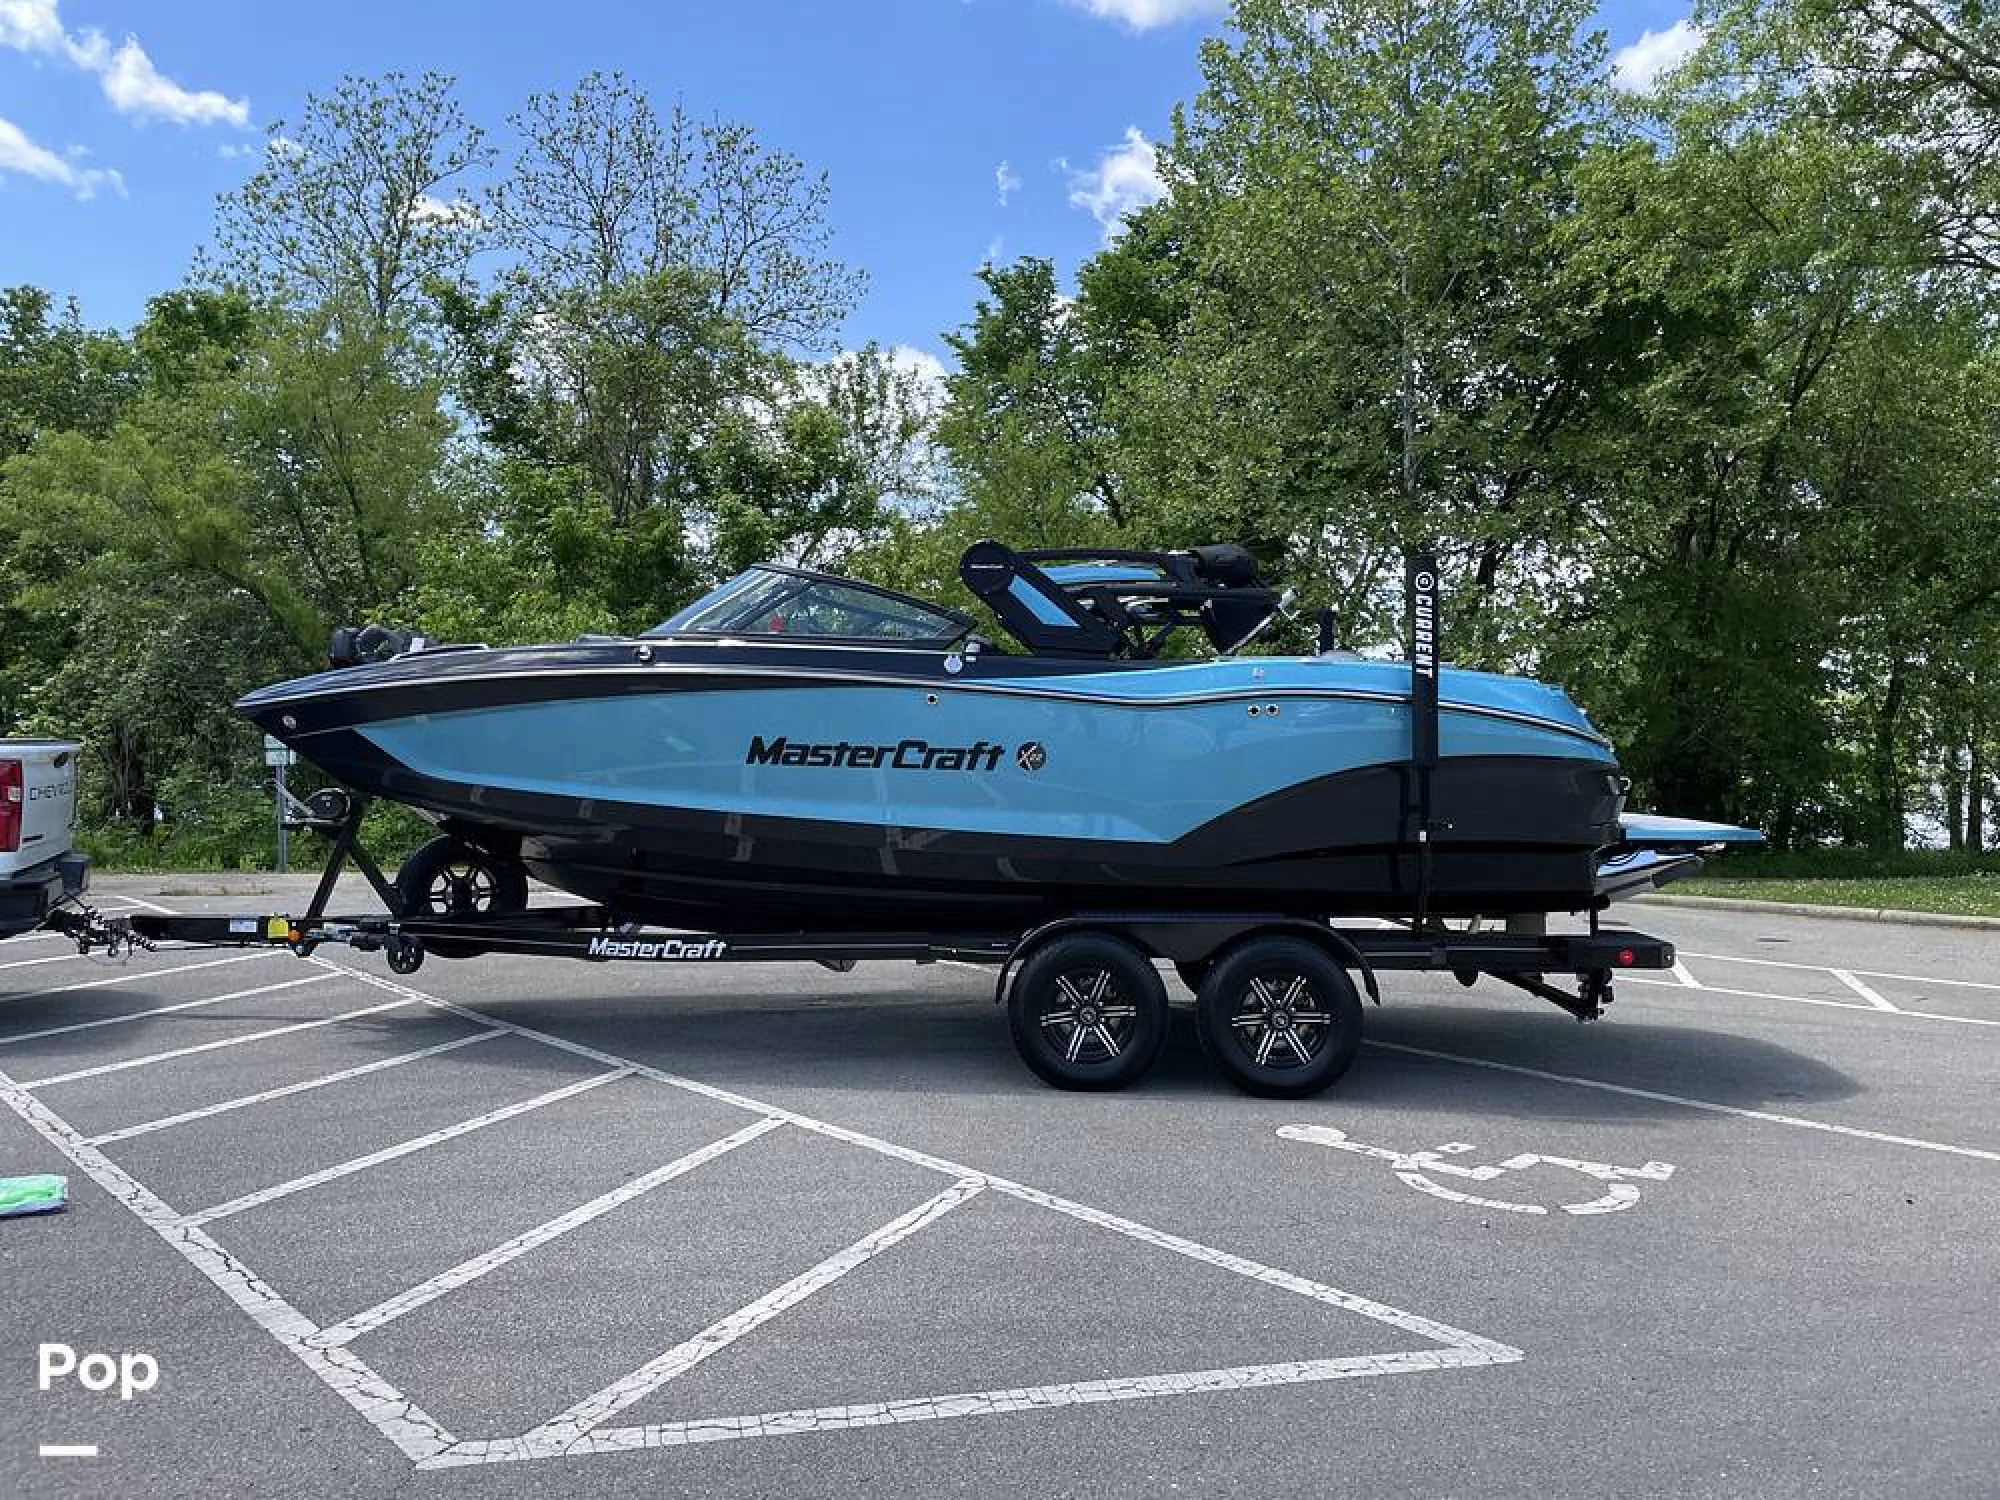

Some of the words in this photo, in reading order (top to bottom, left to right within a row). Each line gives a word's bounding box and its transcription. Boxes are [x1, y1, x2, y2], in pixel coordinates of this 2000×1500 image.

[1416, 594, 1433, 679] CURRENT
[746, 735, 1005, 771] MasterCraft
[588, 937, 727, 959] MasterCraft
